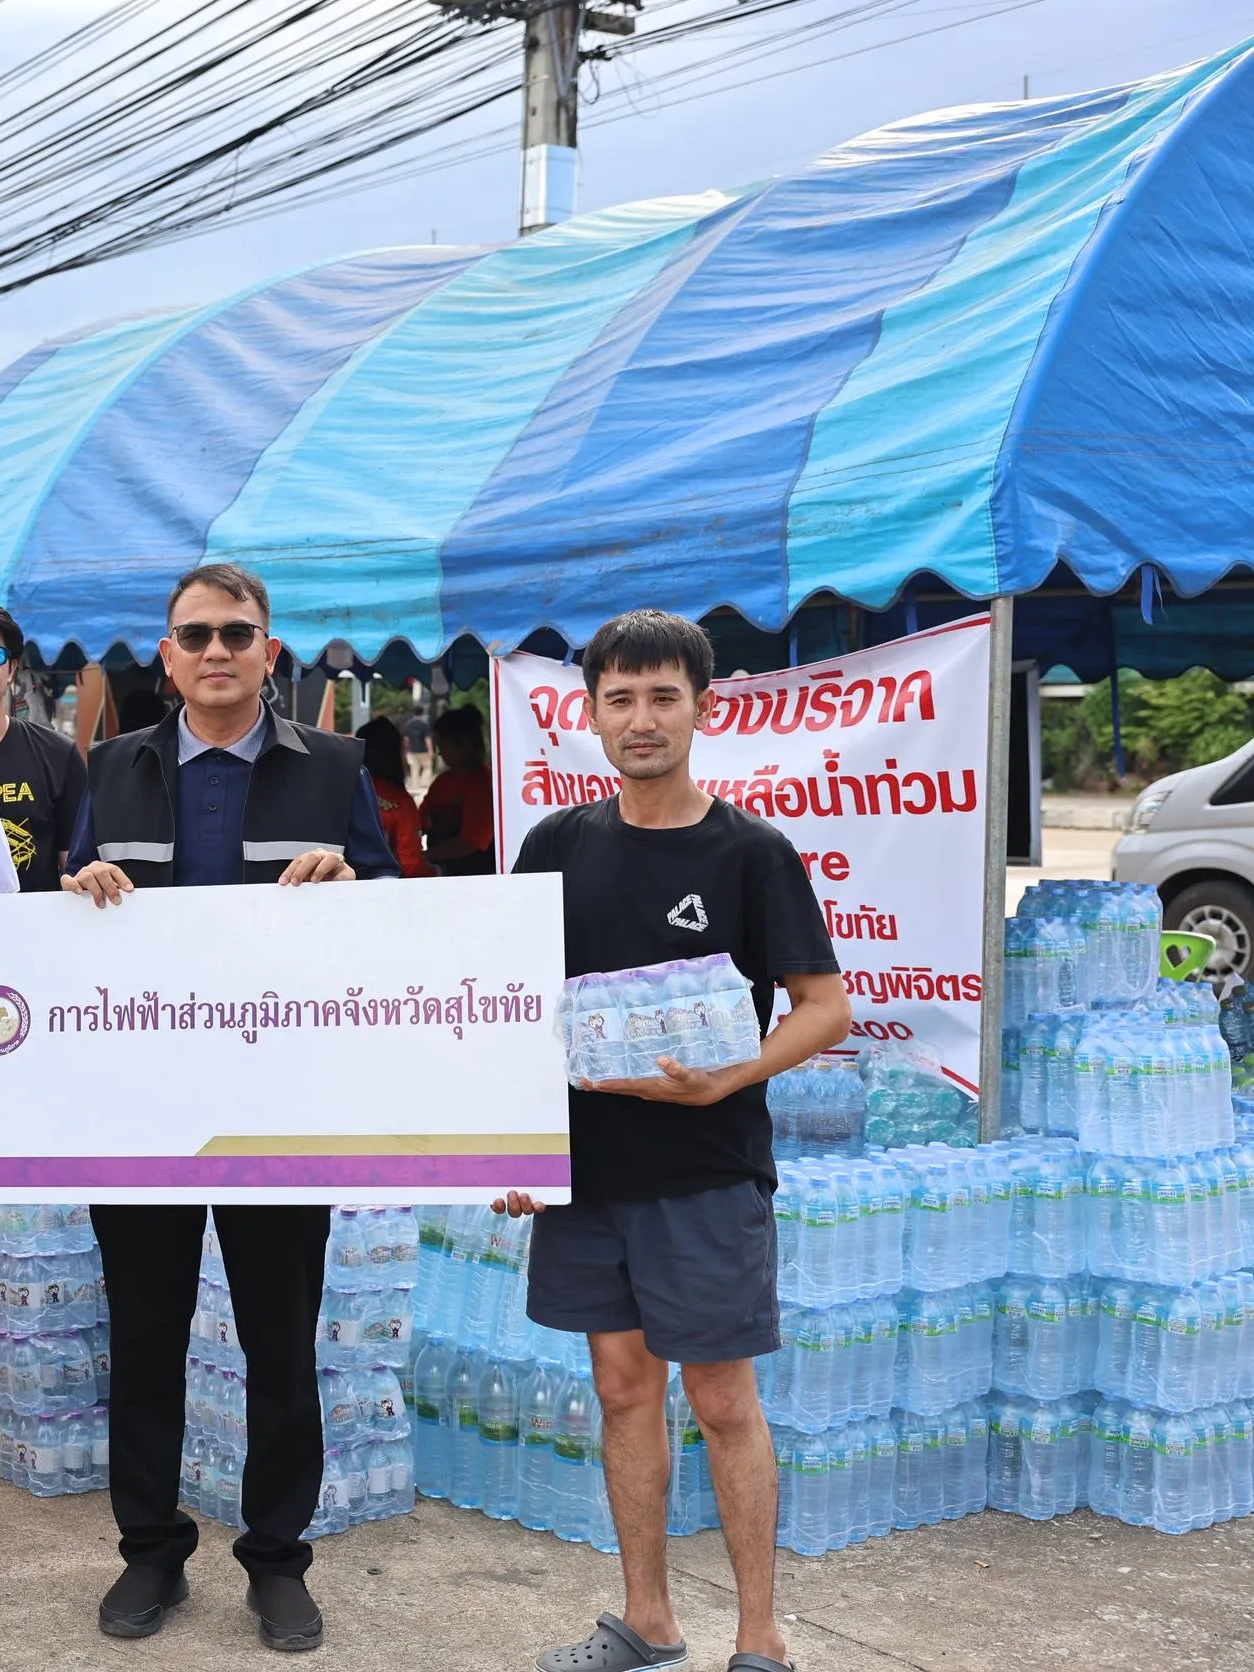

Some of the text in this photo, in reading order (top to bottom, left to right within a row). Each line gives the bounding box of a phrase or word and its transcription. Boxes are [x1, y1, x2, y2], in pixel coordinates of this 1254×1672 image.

[48, 977, 543, 1044] การไฟฟ้าส่วนภูมิภาคจังหวัดสุโขทัย
